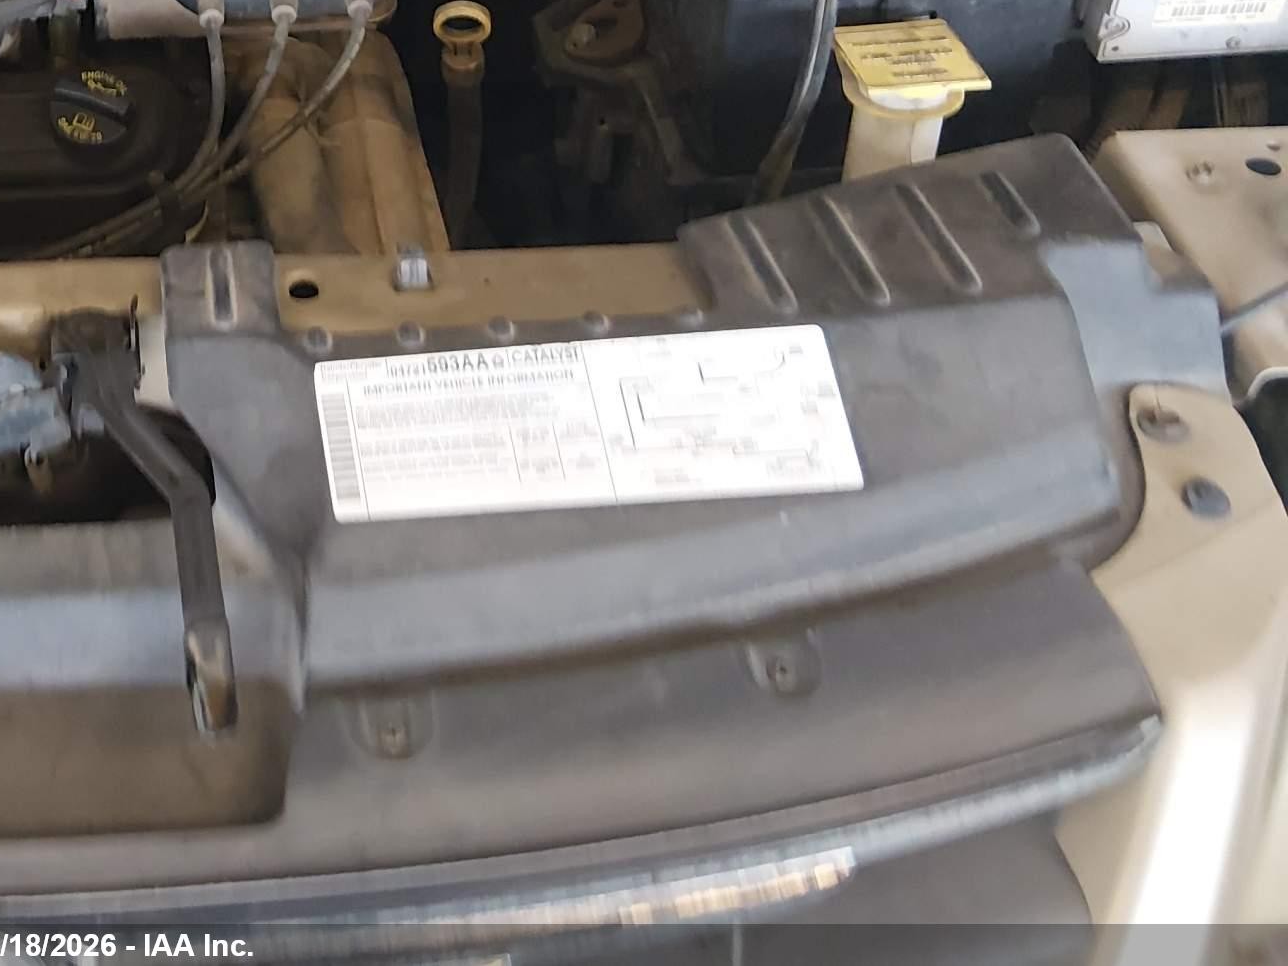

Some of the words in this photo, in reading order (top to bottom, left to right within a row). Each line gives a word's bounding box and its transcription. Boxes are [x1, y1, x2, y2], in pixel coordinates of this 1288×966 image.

[81, 70, 115, 84] ENGINE
[511, 345, 580, 363] CATALYST
[487, 369, 574, 387] INFORMATION
